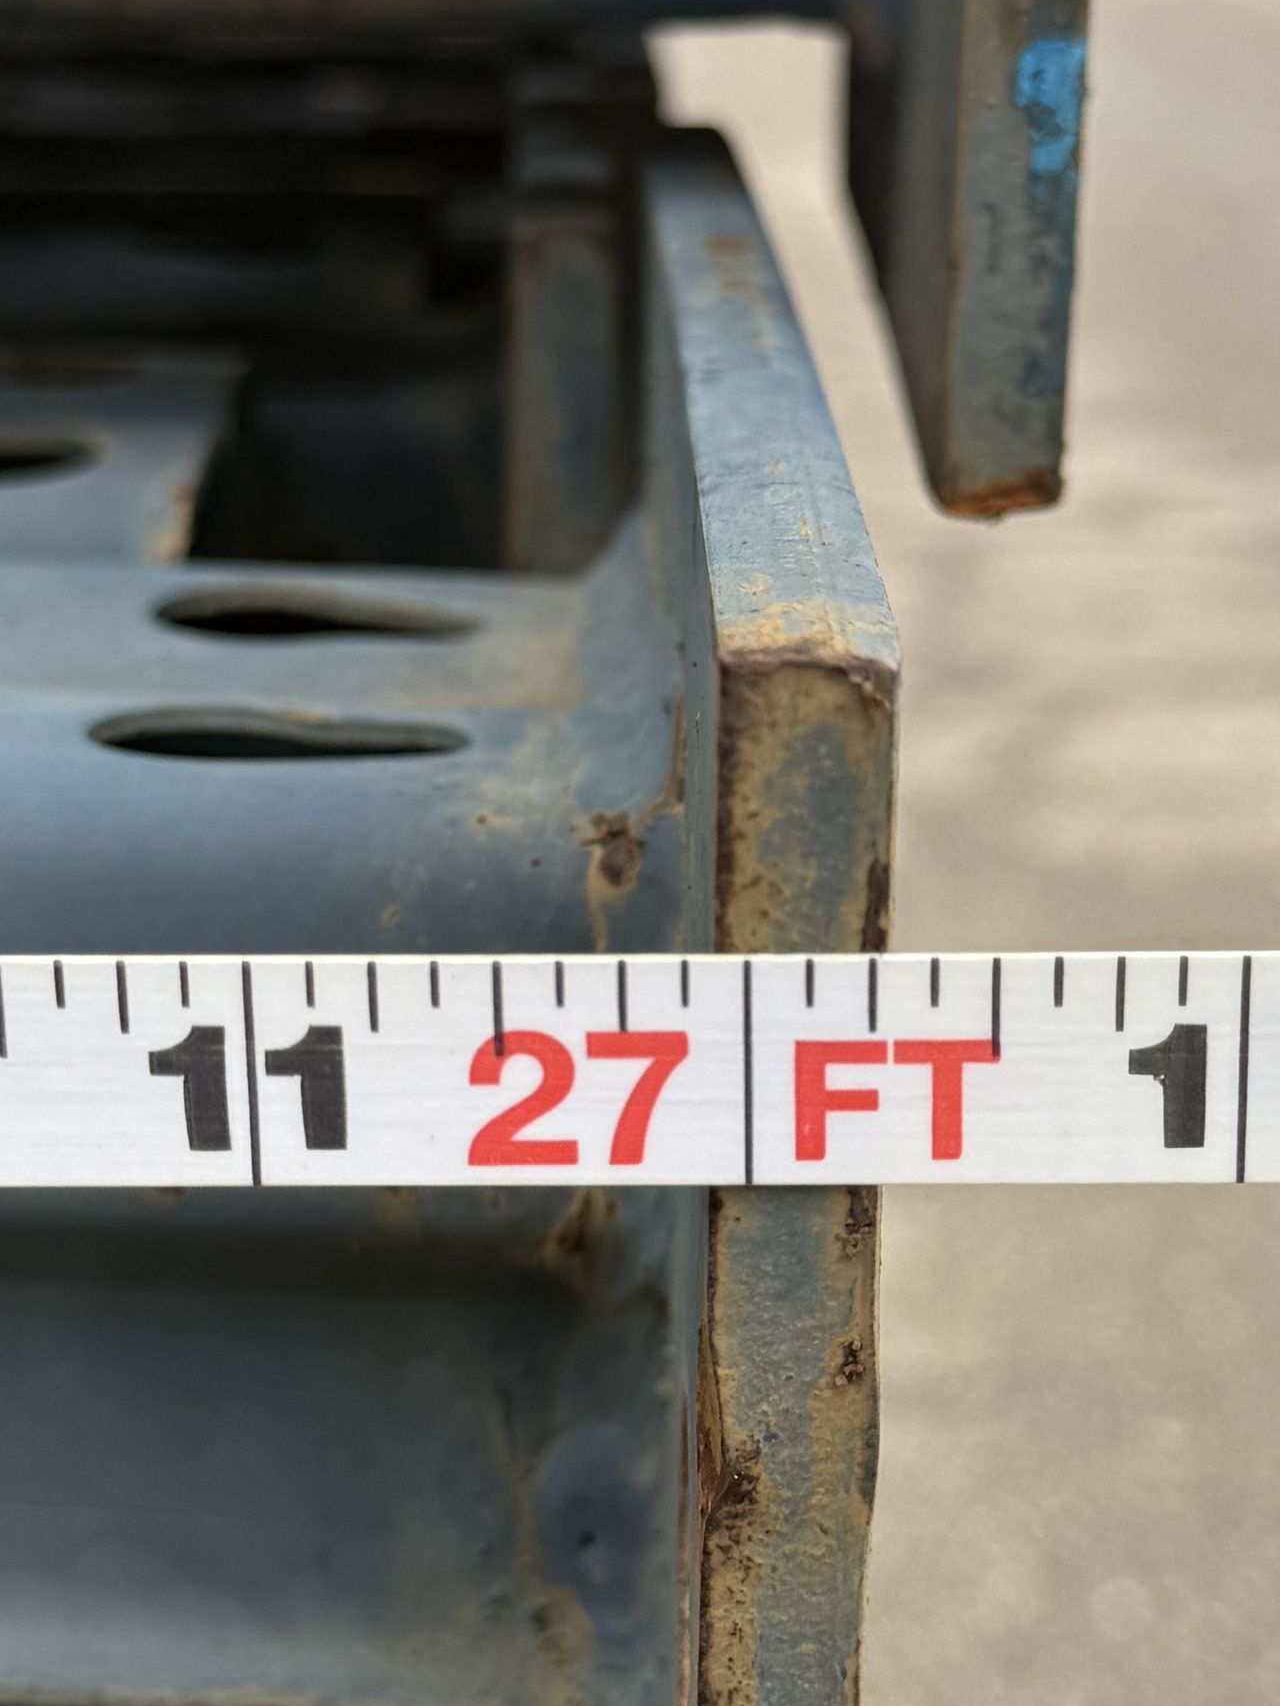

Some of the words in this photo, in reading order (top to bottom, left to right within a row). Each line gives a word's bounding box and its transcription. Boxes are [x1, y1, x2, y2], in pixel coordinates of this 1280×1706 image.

[149, 1025, 348, 1151] 11
[468, 1031, 689, 1167] 27
[794, 1039, 1001, 1161] FT
[1128, 1023, 1207, 1148] 1
